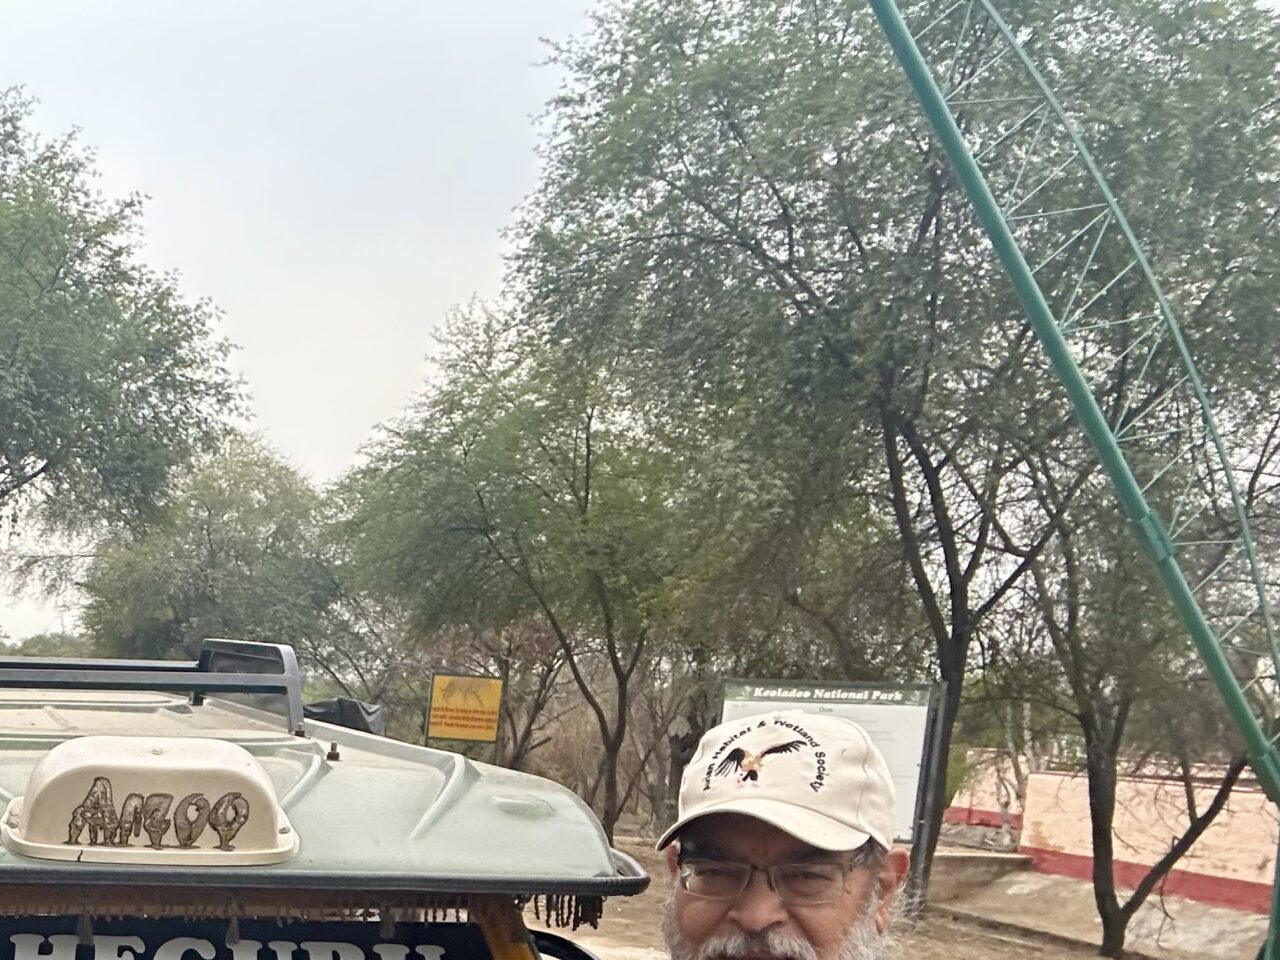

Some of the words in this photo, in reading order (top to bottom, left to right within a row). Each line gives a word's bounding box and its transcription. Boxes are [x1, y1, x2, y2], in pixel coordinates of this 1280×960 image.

[754, 687, 811, 698] Keoladeo
[813, 689, 869, 699] National
[872, 690, 903, 700] Park
[774, 720, 821, 748] Wetland
[809, 751, 827, 792] Society
